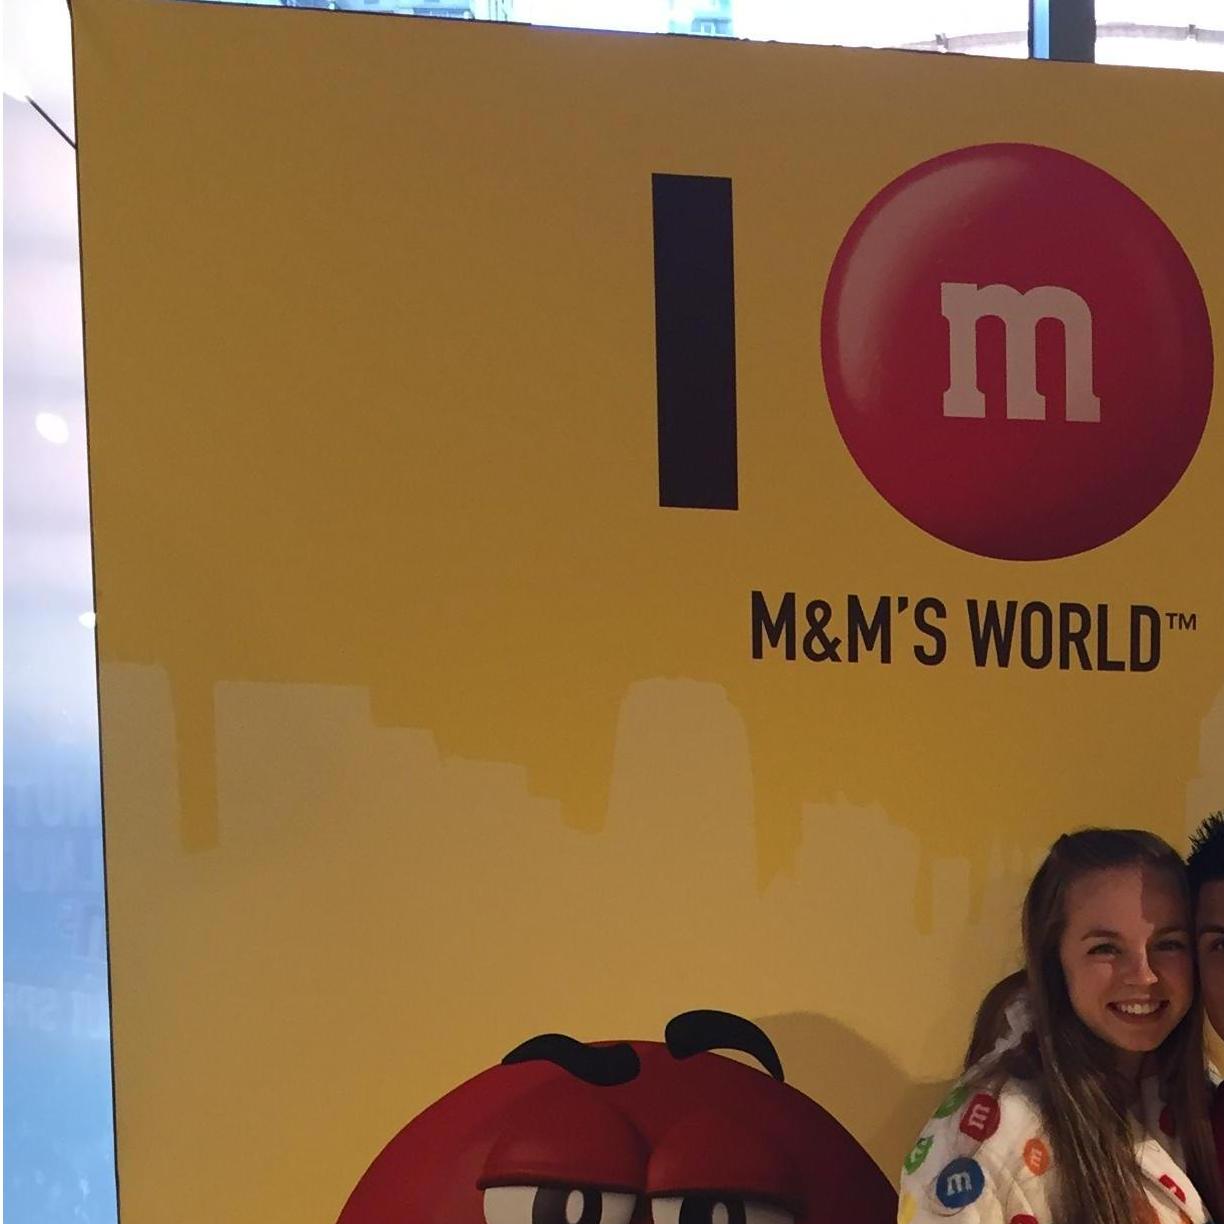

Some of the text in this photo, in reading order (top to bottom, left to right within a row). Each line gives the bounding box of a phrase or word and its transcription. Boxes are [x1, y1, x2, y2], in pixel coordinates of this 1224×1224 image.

[652, 172, 739, 510] I
[940, 281, 1101, 422] m
[751, 590, 947, 666] M&M'S
[947, 1172, 972, 1196] m
